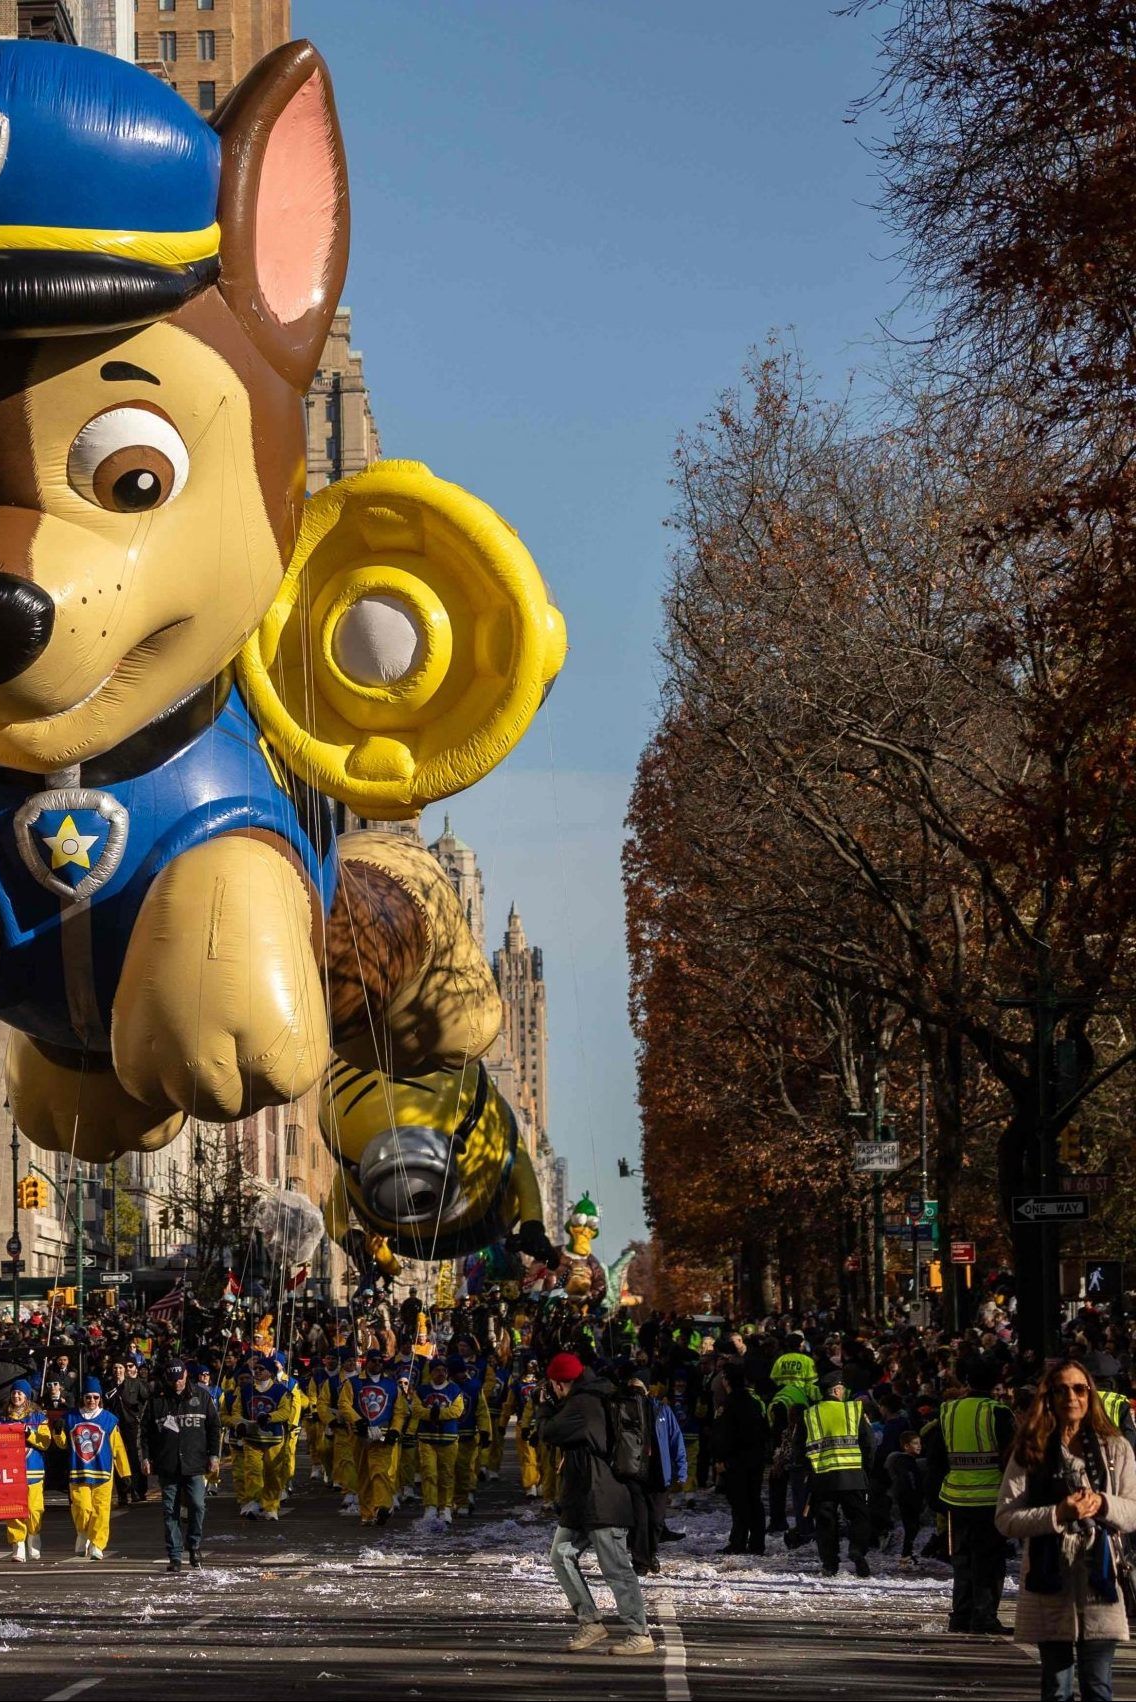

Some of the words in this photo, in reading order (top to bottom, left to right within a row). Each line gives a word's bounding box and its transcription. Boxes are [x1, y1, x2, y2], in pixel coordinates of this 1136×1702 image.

[857, 1145, 896, 1154] PASSENGER
[857, 1156, 875, 1165] CARS
[879, 1155, 896, 1165] ONLY
[1063, 1178, 1071, 1192] W
[1077, 1178, 1091, 1190] 66
[1095, 1176, 1108, 1190] ST
[1025, 1204, 1046, 1214] ONE
[1056, 1203, 1079, 1213] WAY
[781, 1360, 802, 1371] NYPD
